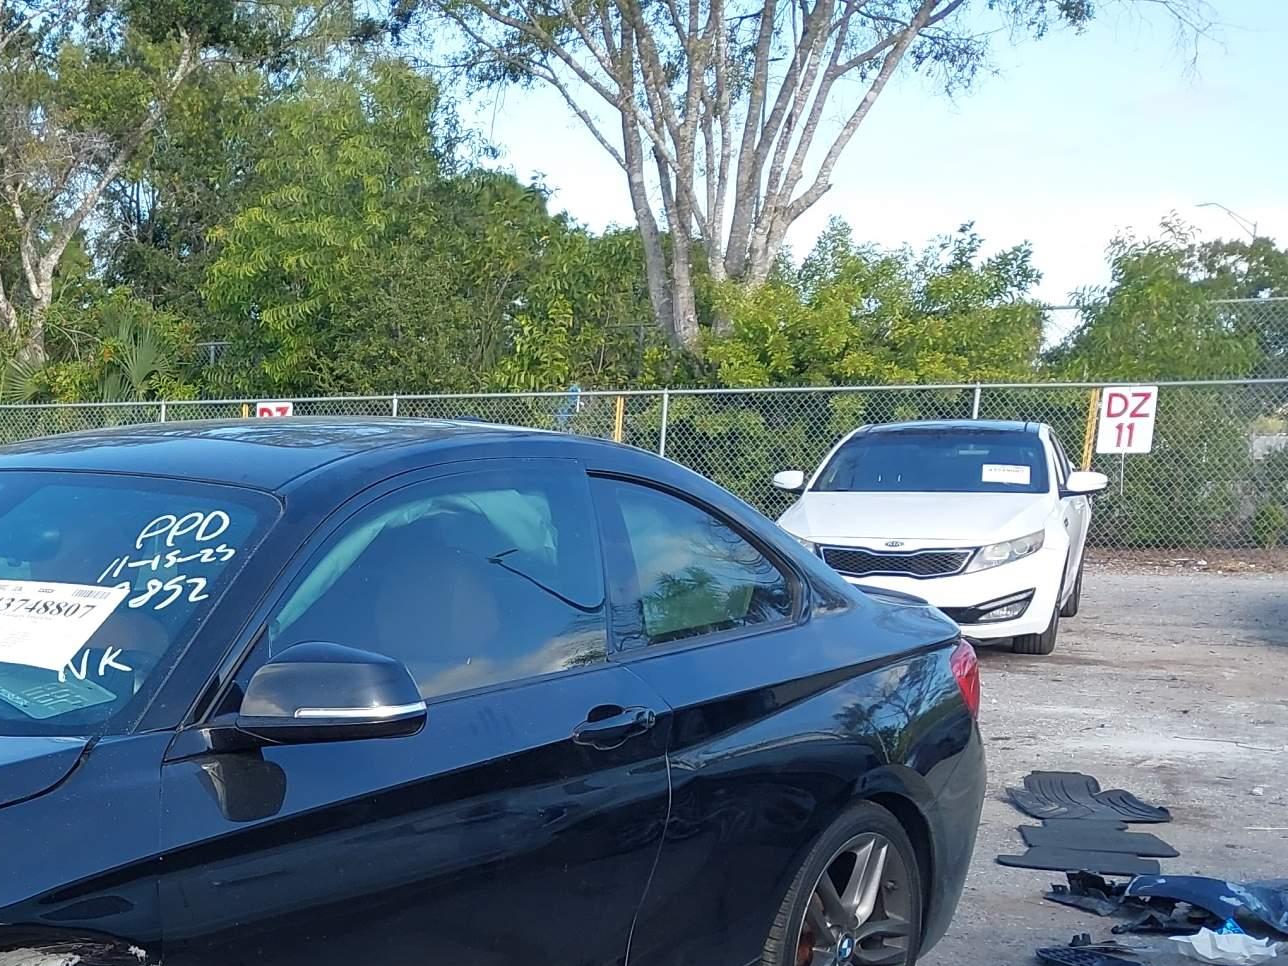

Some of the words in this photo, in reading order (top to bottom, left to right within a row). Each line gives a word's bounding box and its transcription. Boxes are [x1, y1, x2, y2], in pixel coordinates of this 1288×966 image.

[1106, 392, 1152, 418] DZ
[1115, 422, 1135, 447] 11
[136, 510, 230, 549] PPD
